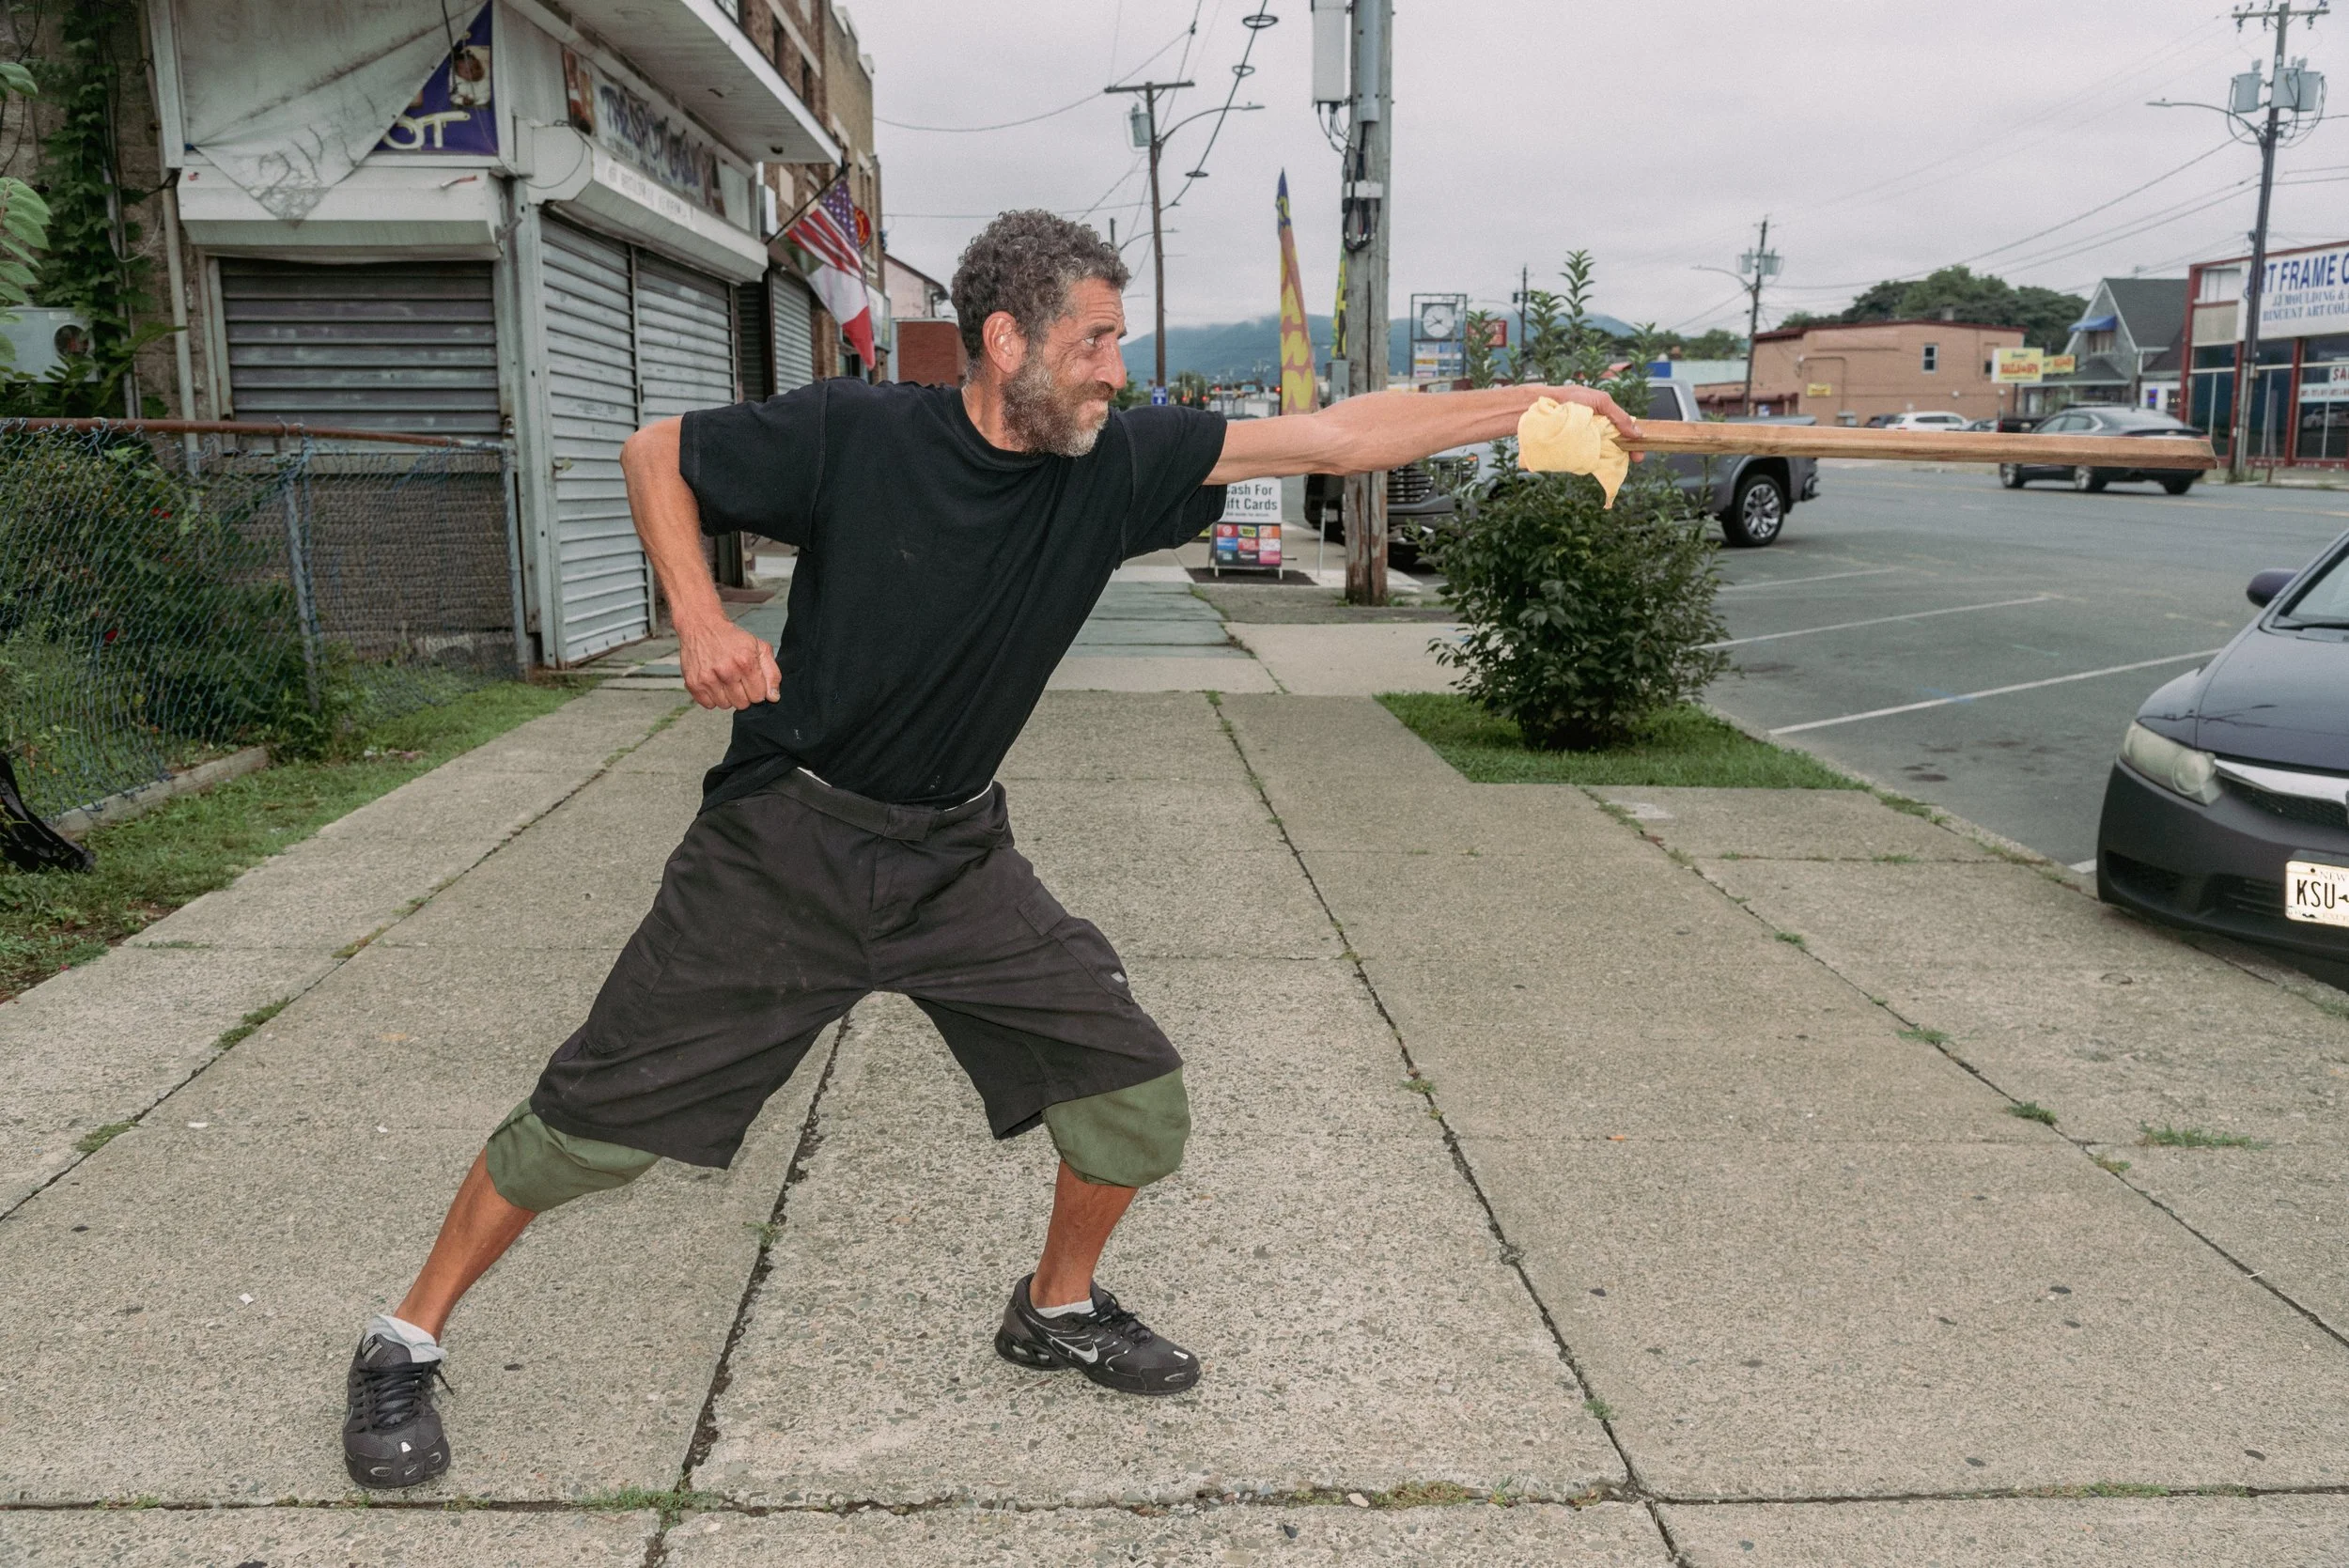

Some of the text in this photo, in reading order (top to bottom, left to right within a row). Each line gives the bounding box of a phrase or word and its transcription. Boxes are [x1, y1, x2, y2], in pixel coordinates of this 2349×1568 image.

[2279, 255, 2338, 291] FRAME
[2333, 366, 2349, 381] SA
[1227, 484, 1273, 495] ash For
[1226, 498, 1278, 510] ift Cards
